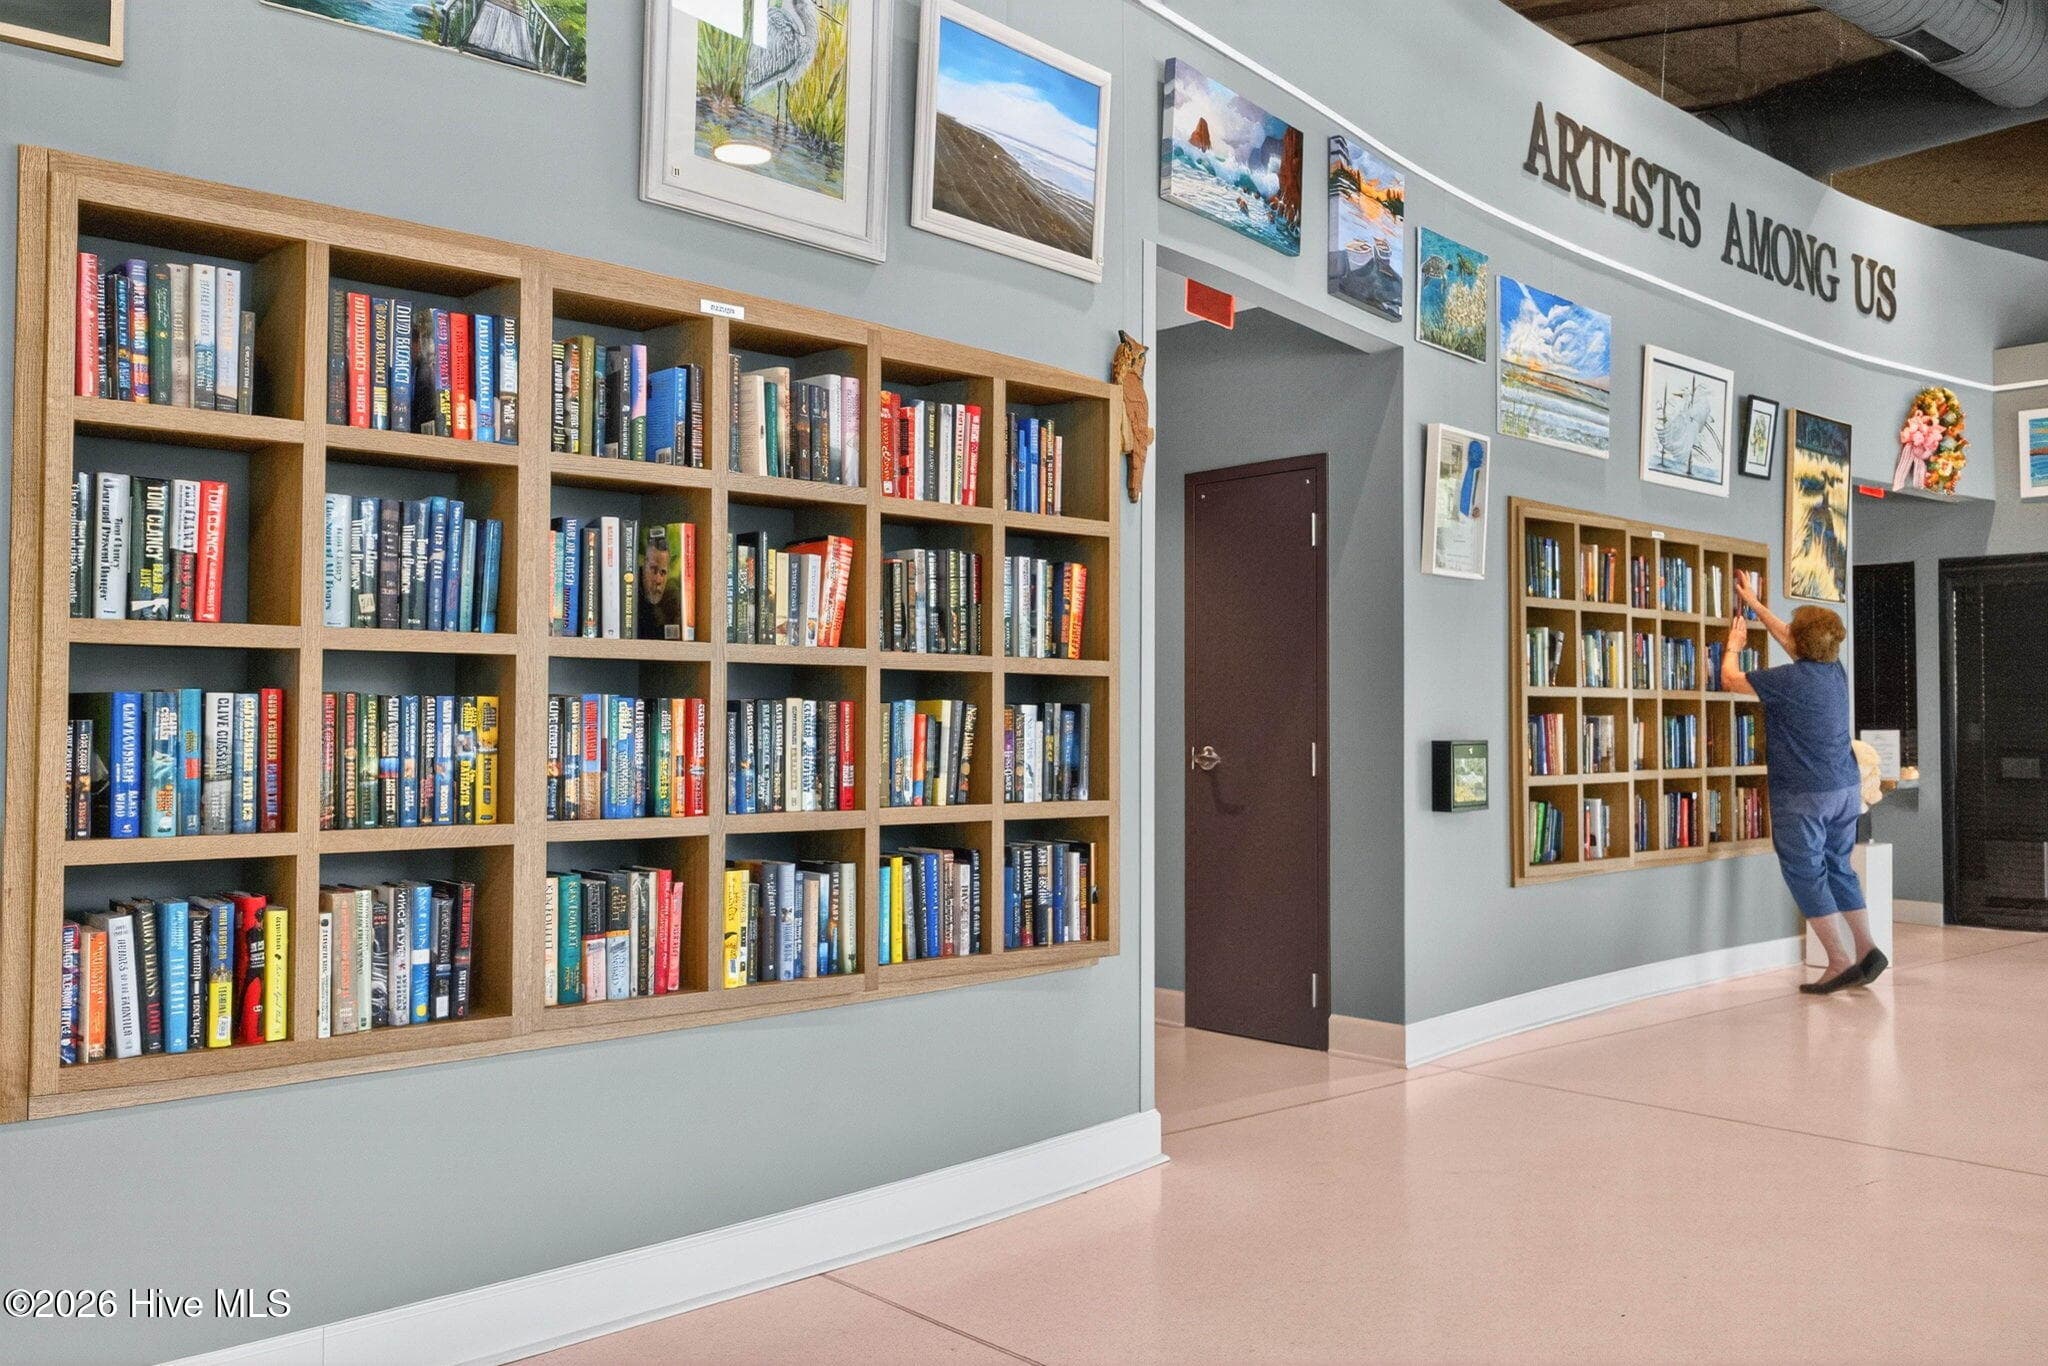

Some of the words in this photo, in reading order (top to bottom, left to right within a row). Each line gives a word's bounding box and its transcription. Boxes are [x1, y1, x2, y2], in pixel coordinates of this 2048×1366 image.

[1523, 101, 1701, 249] ARTISTS
[1720, 202, 1840, 302] AMONG
[1851, 253, 1897, 323] US
[480, 319, 491, 352] DAVID
[395, 337, 410, 383] BALDACCI
[480, 355, 491, 410] BALDACCI
[147, 485, 165, 510] TOM
[208, 485, 224, 512] TOM
[114, 518, 123, 536] Tom
[146, 515, 163, 560] CLANCY
[183, 510, 196, 551] CLANCY
[206, 515, 219, 560] CLANCY
[352, 520, 363, 552] Without
[403, 525, 414, 557] Without
[566, 520, 576, 553] HARLAN
[101, 527, 111, 563] Present
[110, 538, 123, 569] Clancy
[351, 554, 362, 590] Remorse
[363, 551, 377, 578] Clancy
[402, 558, 413, 594] Remorse
[413, 556, 427, 582] Clancy
[565, 556, 574, 586] COBEN
[99, 566, 111, 600] Danger
[123, 703, 135, 736] CLIVE
[217, 697, 229, 728] CLIVE
[244, 697, 256, 728] CLIVE
[121, 736, 135, 783] CUSSLER
[216, 730, 229, 776] CUSSLER
[243, 729, 254, 772] CUSSLER
[243, 776, 254, 800] FIRE
[243, 803, 253, 821] ICE
[568, 881, 578, 903] KEN
[140, 910, 154, 952] AARON
[568, 906, 578, 947] FOLLETT
[144, 954, 157, 997] ELKINS
[121, 996, 133, 1037] FRONTIER
[148, 1002, 160, 1035] LOOT
